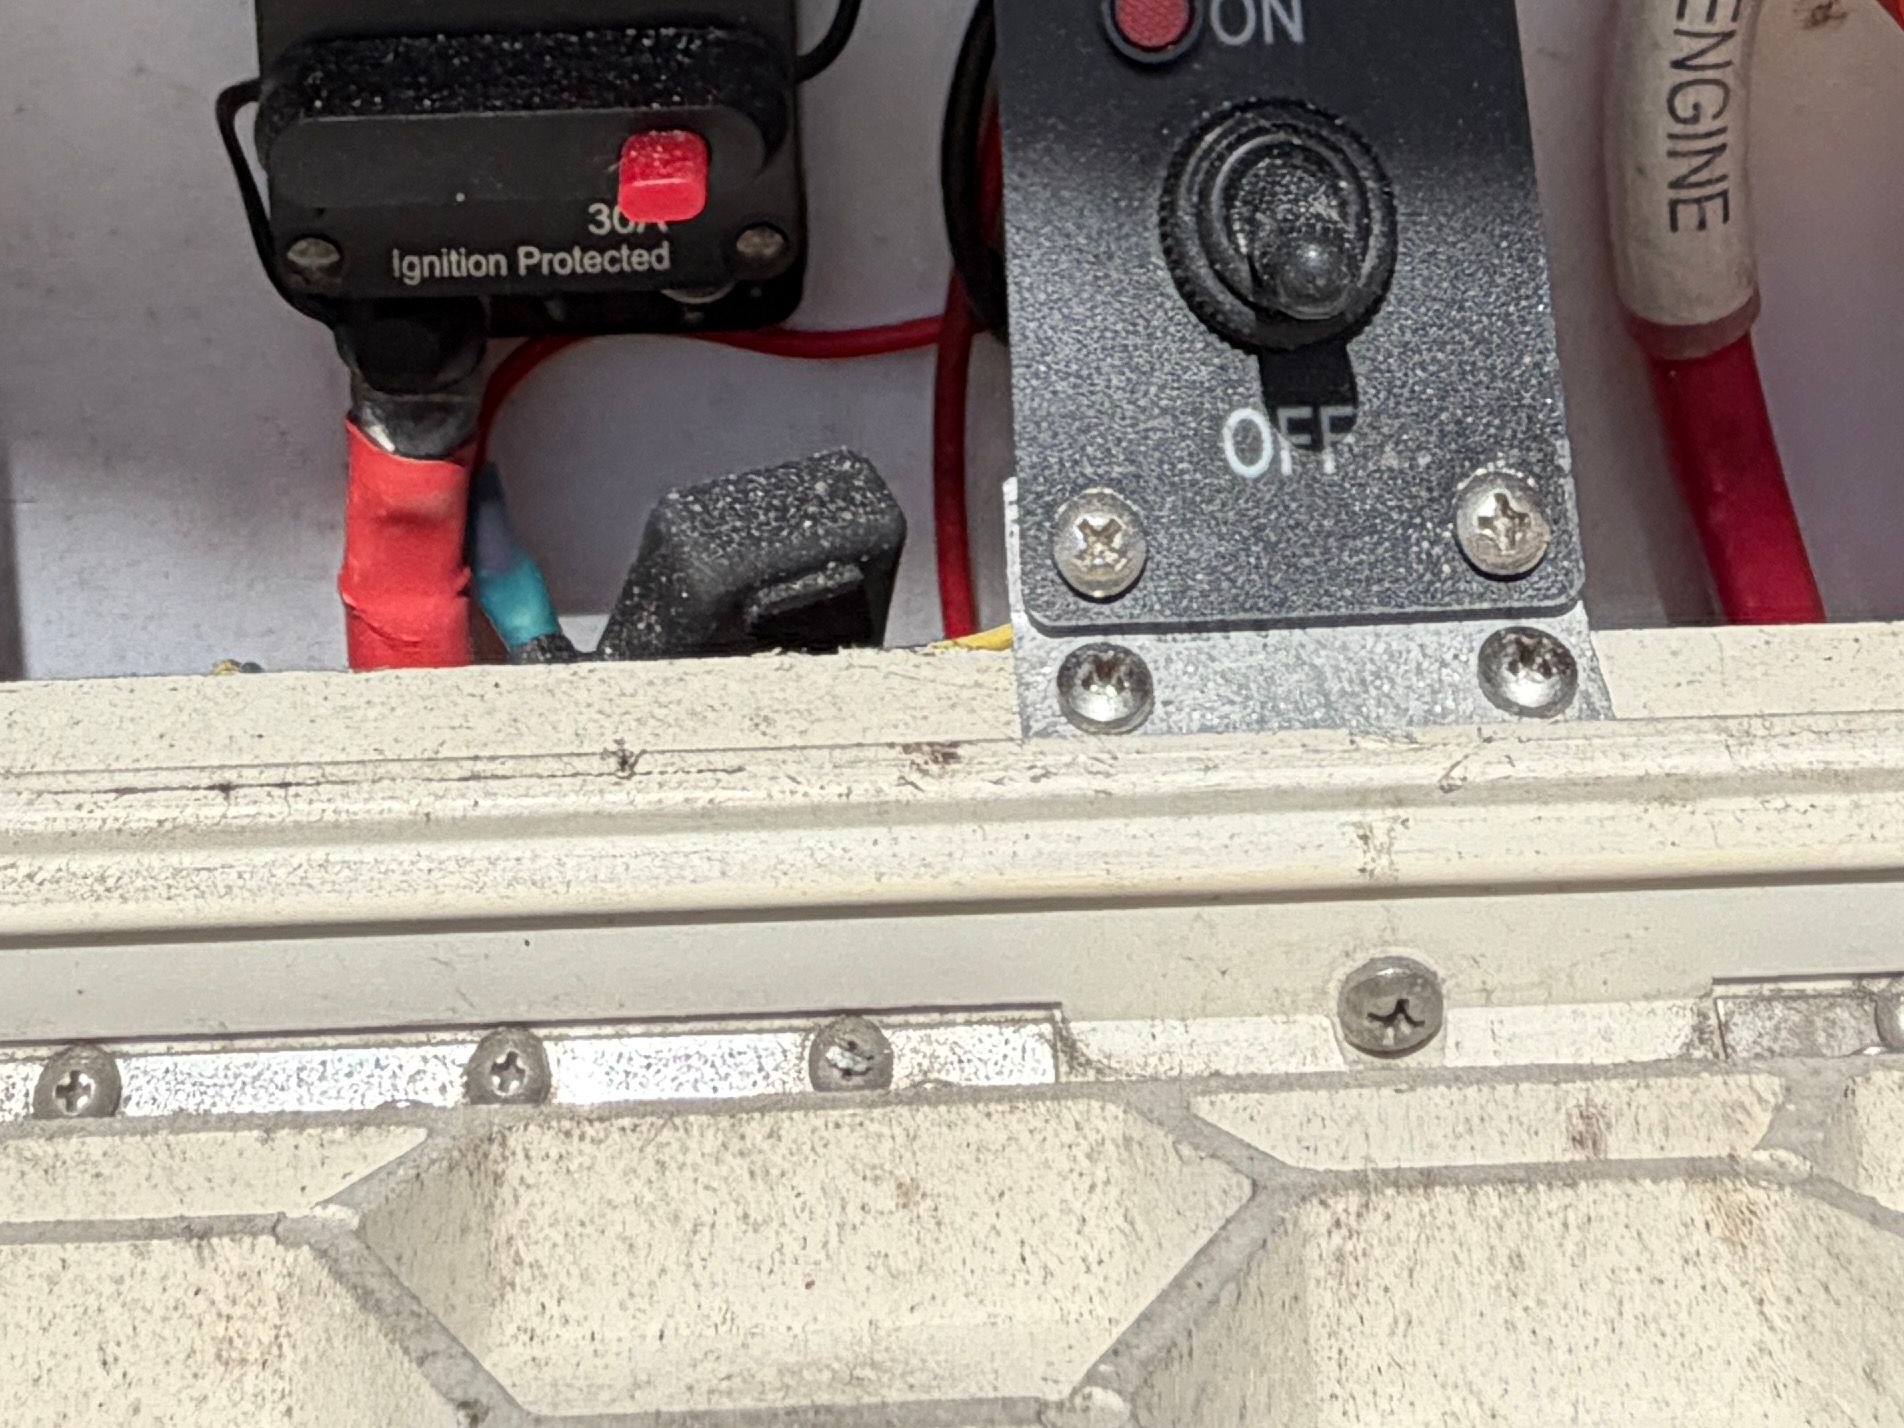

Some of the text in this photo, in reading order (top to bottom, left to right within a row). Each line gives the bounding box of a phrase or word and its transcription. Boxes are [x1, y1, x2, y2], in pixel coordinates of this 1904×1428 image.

[392, 241, 671, 286] Ignition Protected
[1223, 404, 1359, 478] OFF
